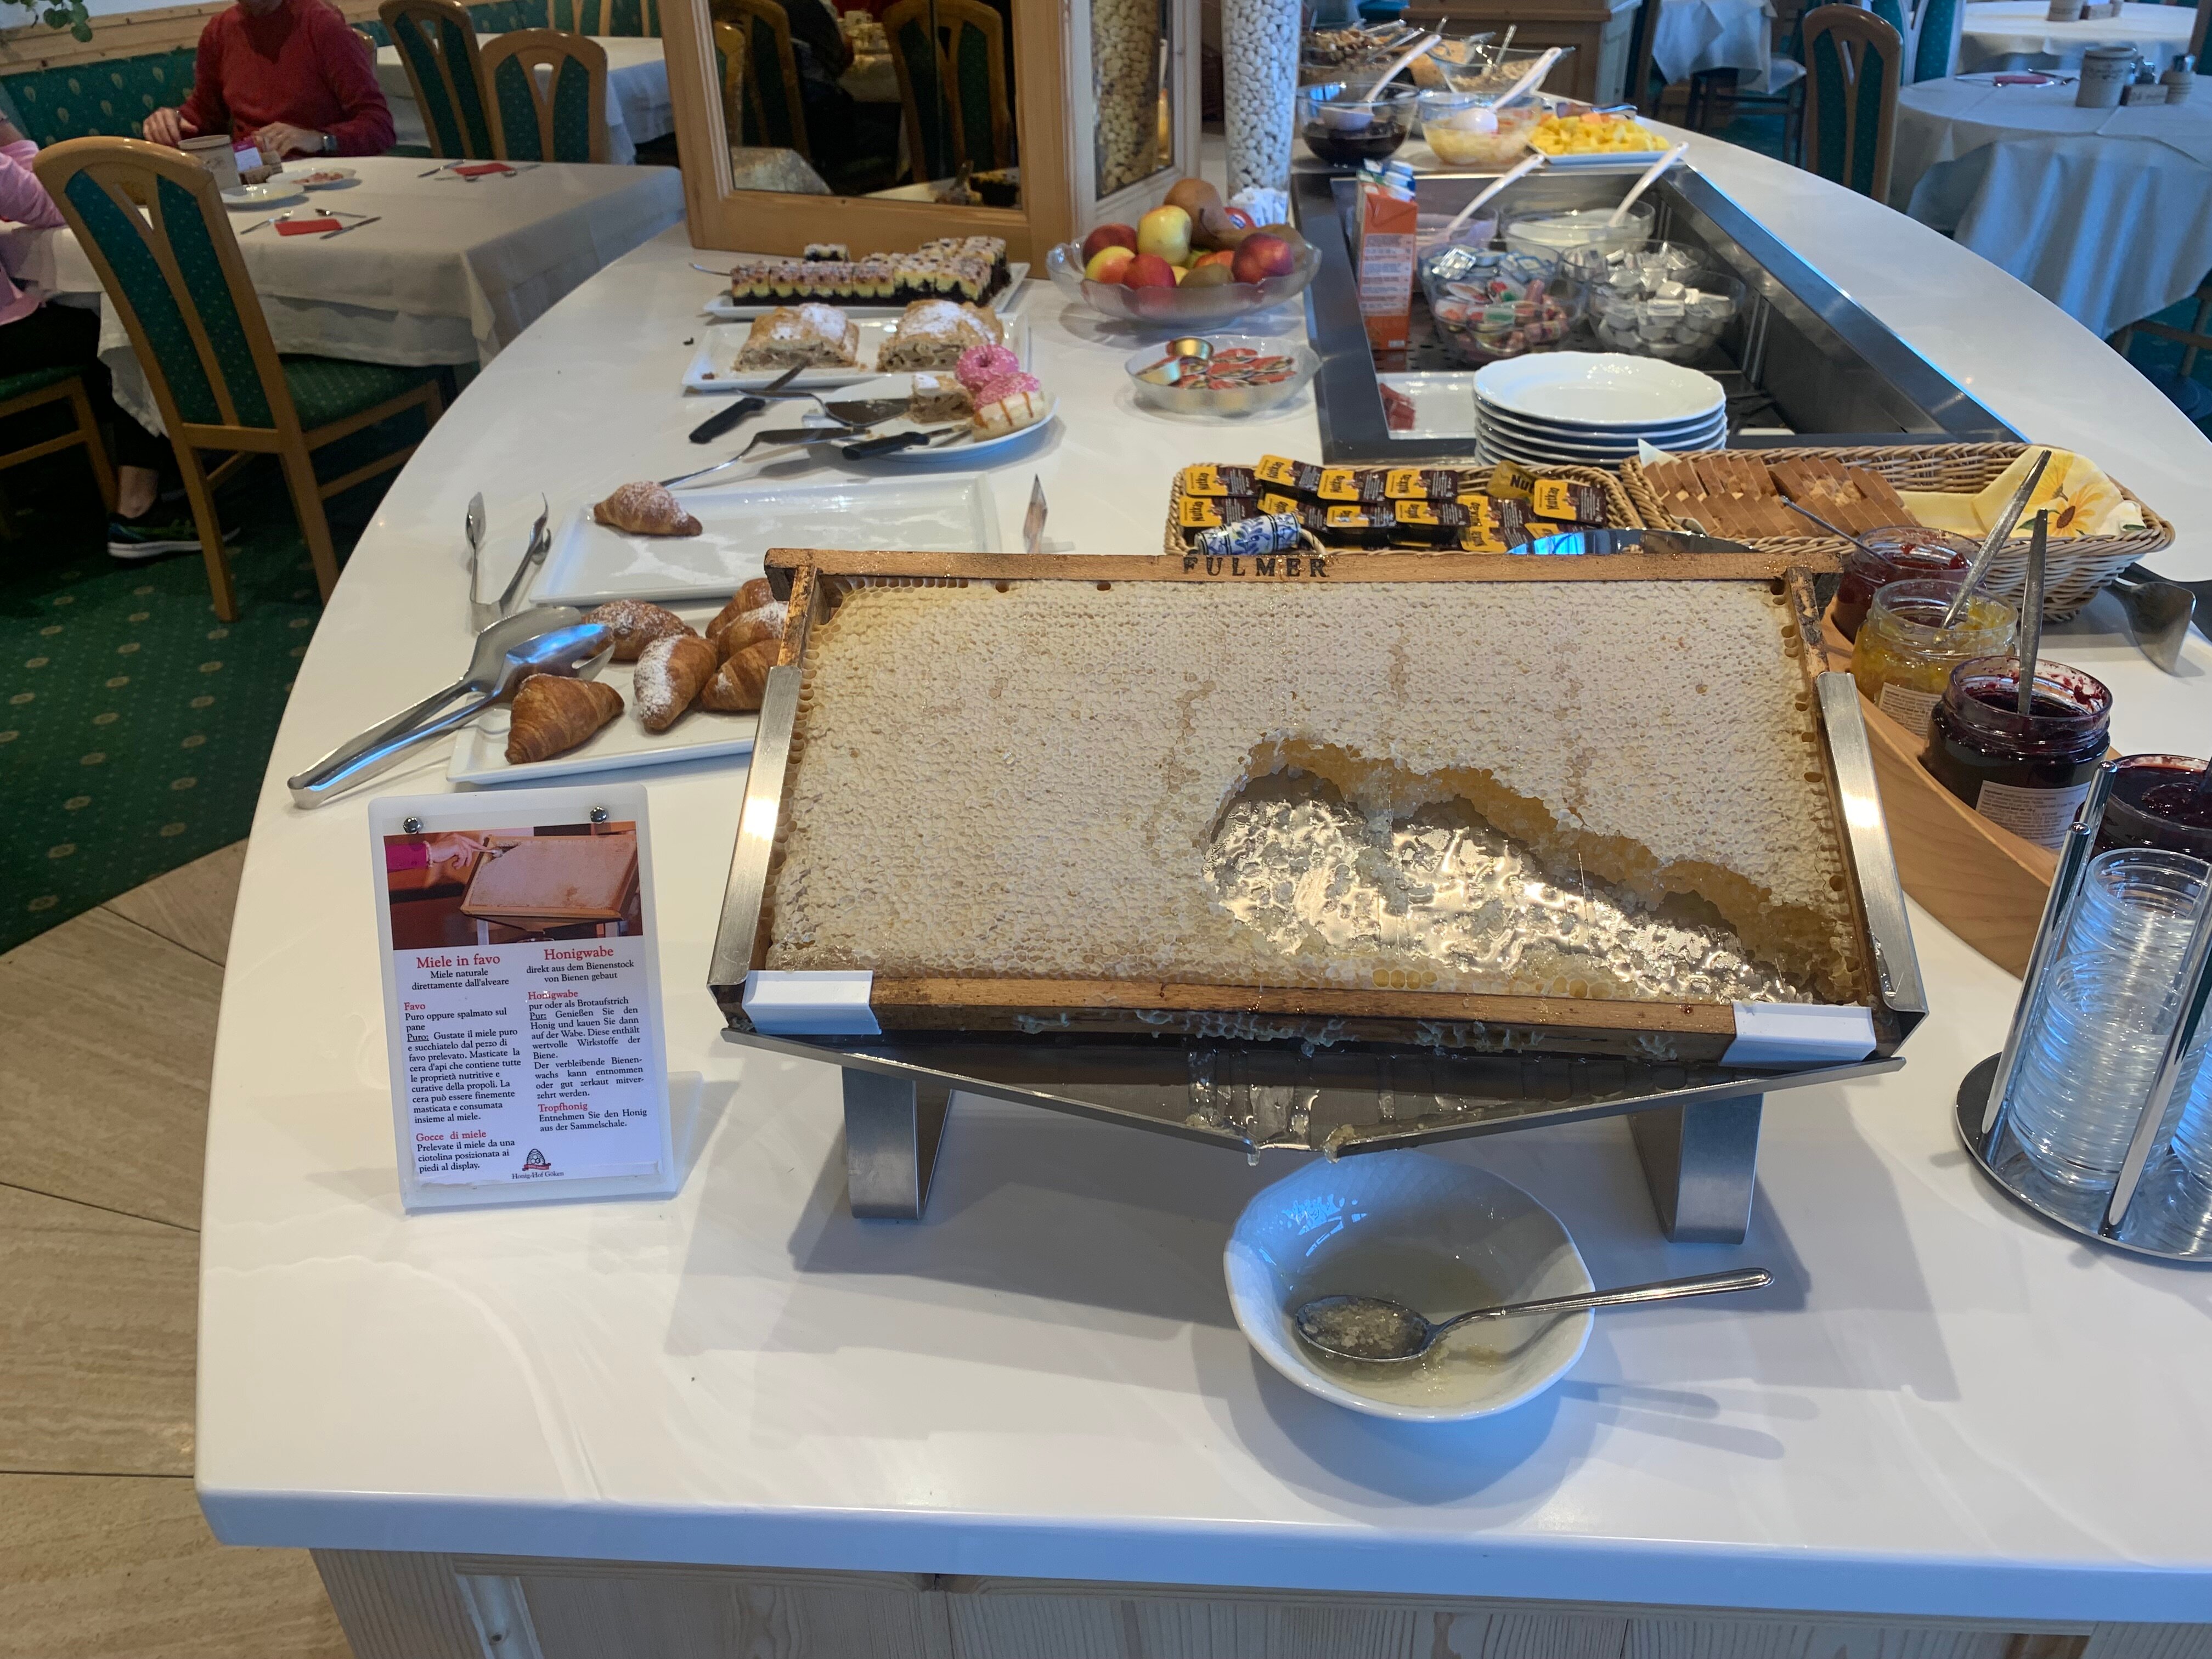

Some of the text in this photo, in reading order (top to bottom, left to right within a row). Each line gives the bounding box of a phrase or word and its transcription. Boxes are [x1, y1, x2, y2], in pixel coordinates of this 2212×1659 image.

[1545, 487, 1560, 510] Nutkao
[1183, 557, 1330, 577] FULMER
[544, 945, 614, 961] Honigwabe
[416, 953, 500, 969] Miele in favo
[526, 964, 550, 974] direkt
[567, 963, 584, 971] dem
[586, 960, 634, 970] Bienenstock
[430, 967, 488, 979] Miele naturale
[561, 973, 590, 982] Bienen
[591, 971, 618, 981] gebaut
[411, 978, 509, 990] direttamente dall'alveare
[528, 989, 578, 1001] Honigwabe
[404, 1002, 426, 1011] Favo
[528, 996, 629, 1012] pur oder als Brotaufstrich
[405, 1007, 507, 1022] Puro oppure spalmato sul
[529, 1006, 638, 1021] Pur: Genießen Sie den
[405, 1024, 426, 1033] pane
[530, 1016, 639, 1030] Honig und kauen Sie dann
[407, 1029, 518, 1043] Puro: Gustate il miele puro
[531, 1025, 640, 1040] auf der Wabe. Diese enthält
[414, 1041, 459, 1052] succhiatelo
[460, 1040, 473, 1048] dal
[475, 1041, 498, 1049] pezzo
[499, 1038, 507, 1046] di
[532, 1040, 568, 1049] wertvolle
[577, 1036, 619, 1047] Wirkstoffe
[409, 1053, 426, 1062] favo
[427, 1052, 467, 1063] prelevato.
[469, 1049, 508, 1058] Masticate
[533, 1051, 558, 1060] Biene.
[428, 1062, 447, 1073] d'api
[449, 1061, 463, 1070] che
[465, 1060, 500, 1069] contiene
[555, 1057, 605, 1068] verbleibende
[611, 1057, 642, 1065] Bienen-
[410, 1074, 417, 1082] le
[420, 1073, 456, 1084] proprietà
[458, 1070, 493, 1080] nutritive
[534, 1067, 644, 1079] wachs kann entnommen
[411, 1079, 510, 1093] curative della propoli. La
[535, 1081, 554, 1090] oder
[560, 1081, 573, 1090] gut
[580, 1077, 609, 1086] zerkaut
[431, 1093, 447, 1104] può
[475, 1091, 515, 1099] finemente
[537, 1088, 590, 1099] zehrt werden.
[413, 1104, 451, 1114] masticata
[459, 1102, 503, 1110] consumata
[537, 1102, 588, 1113] Tropfhonig
[414, 1112, 481, 1124] insieme al miele.
[539, 1108, 647, 1122] Entnehmen Sie den Honig
[555, 1122, 568, 1131] der
[570, 1119, 627, 1130] Sammelschale.
[416, 1130, 487, 1142] Gocce di miele
[416, 1143, 454, 1152] Prelevate
[456, 1141, 462, 1149] il
[464, 1139, 486, 1149] miele
[488, 1139, 498, 1147] da
[417, 1153, 453, 1162] ciotolina
[454, 1150, 500, 1162] posizionata
[419, 1161, 480, 1174] piedi al display.
[511, 1171, 544, 1180] Honig-Hof
